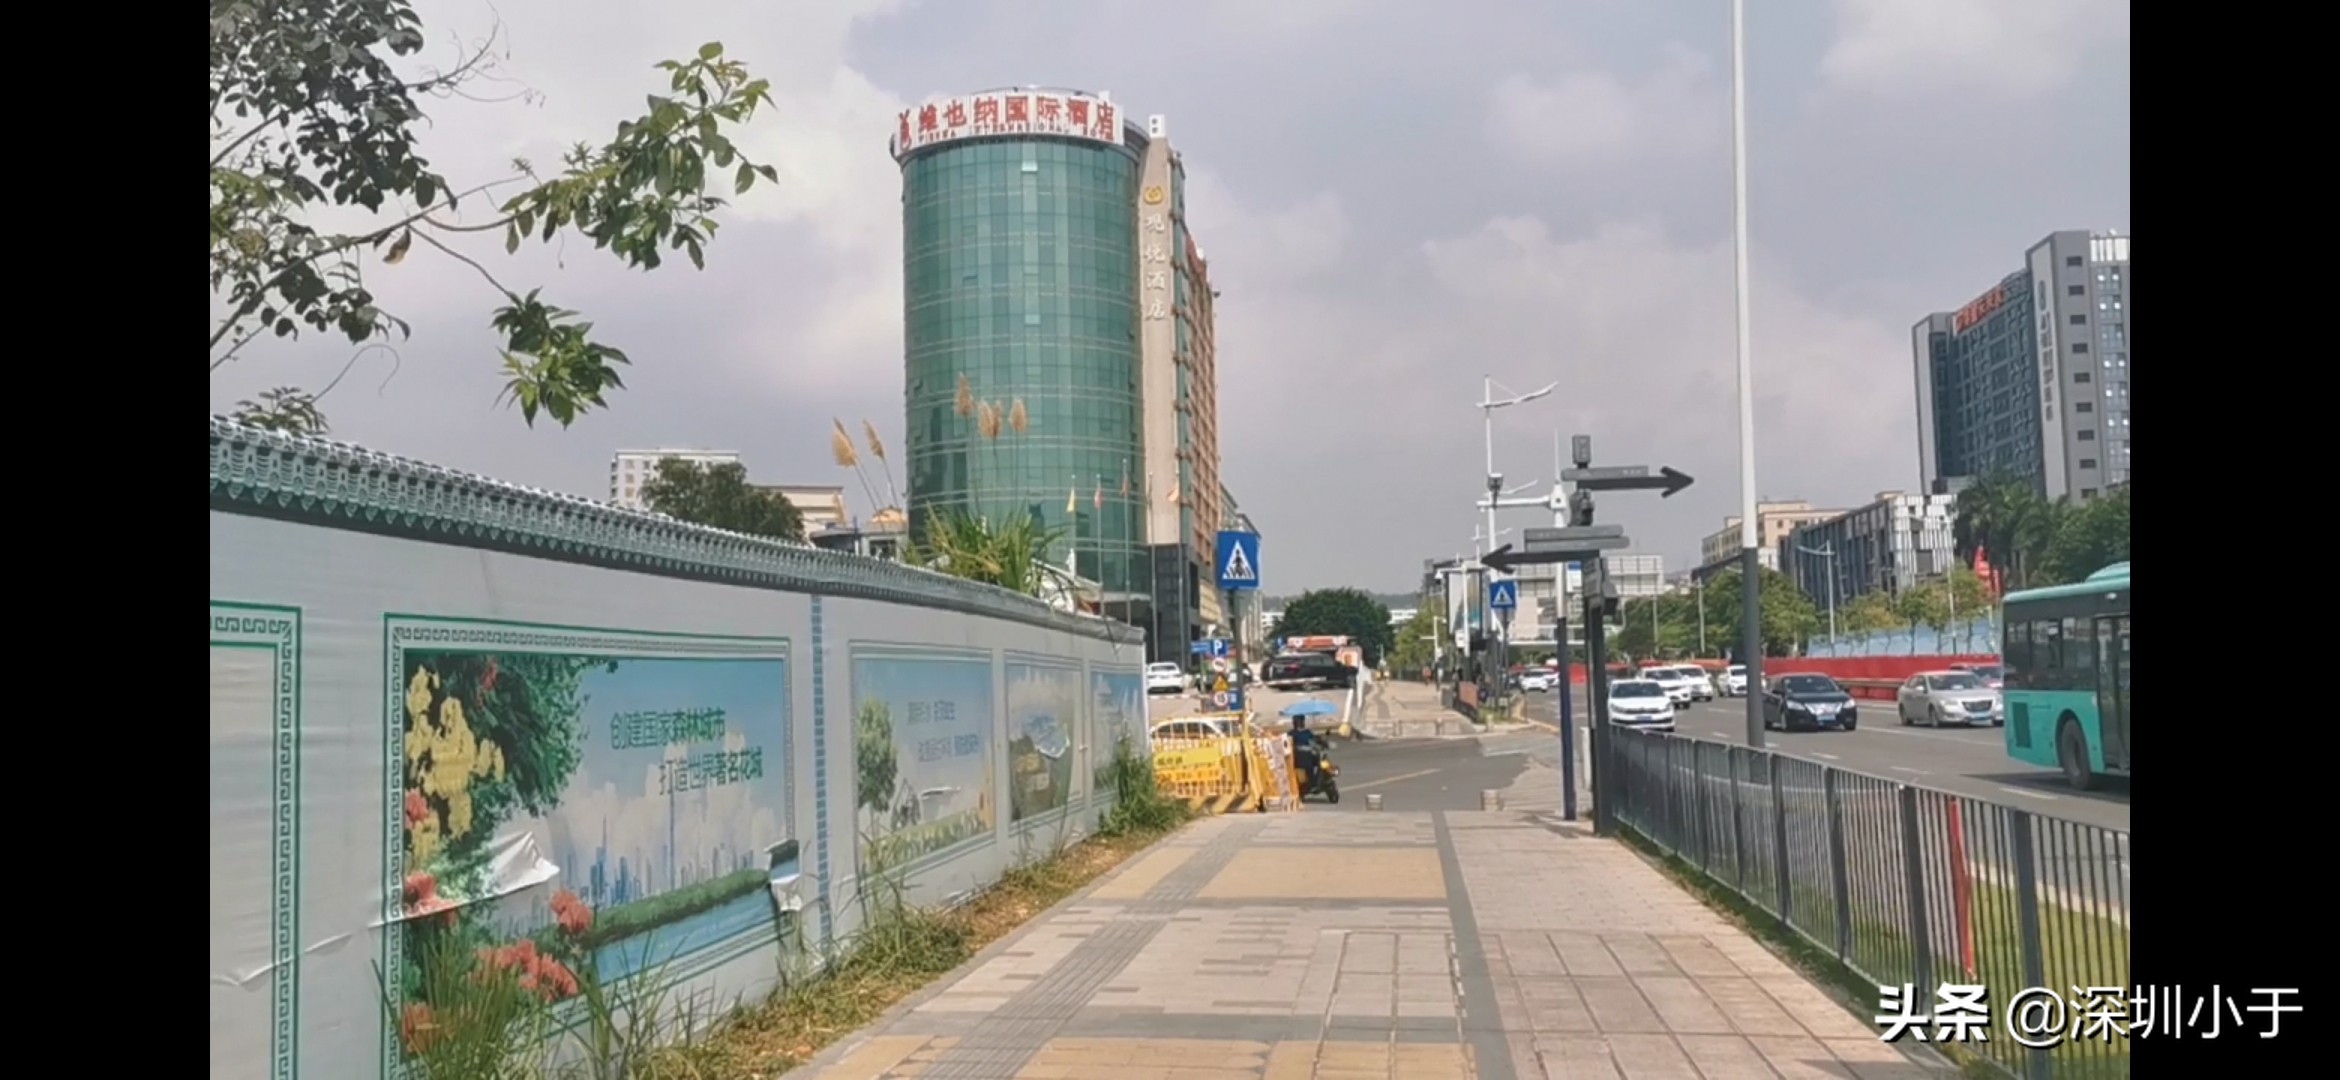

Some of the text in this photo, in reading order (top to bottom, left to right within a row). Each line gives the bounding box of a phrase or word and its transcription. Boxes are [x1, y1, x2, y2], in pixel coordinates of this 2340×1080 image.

[918, 95, 1114, 142] 维也纳国际酒店
[1213, 639, 1223, 655] P
[610, 707, 726, 750] 创建国家森林城市
[658, 746, 763, 795] 打造世界著名花城
